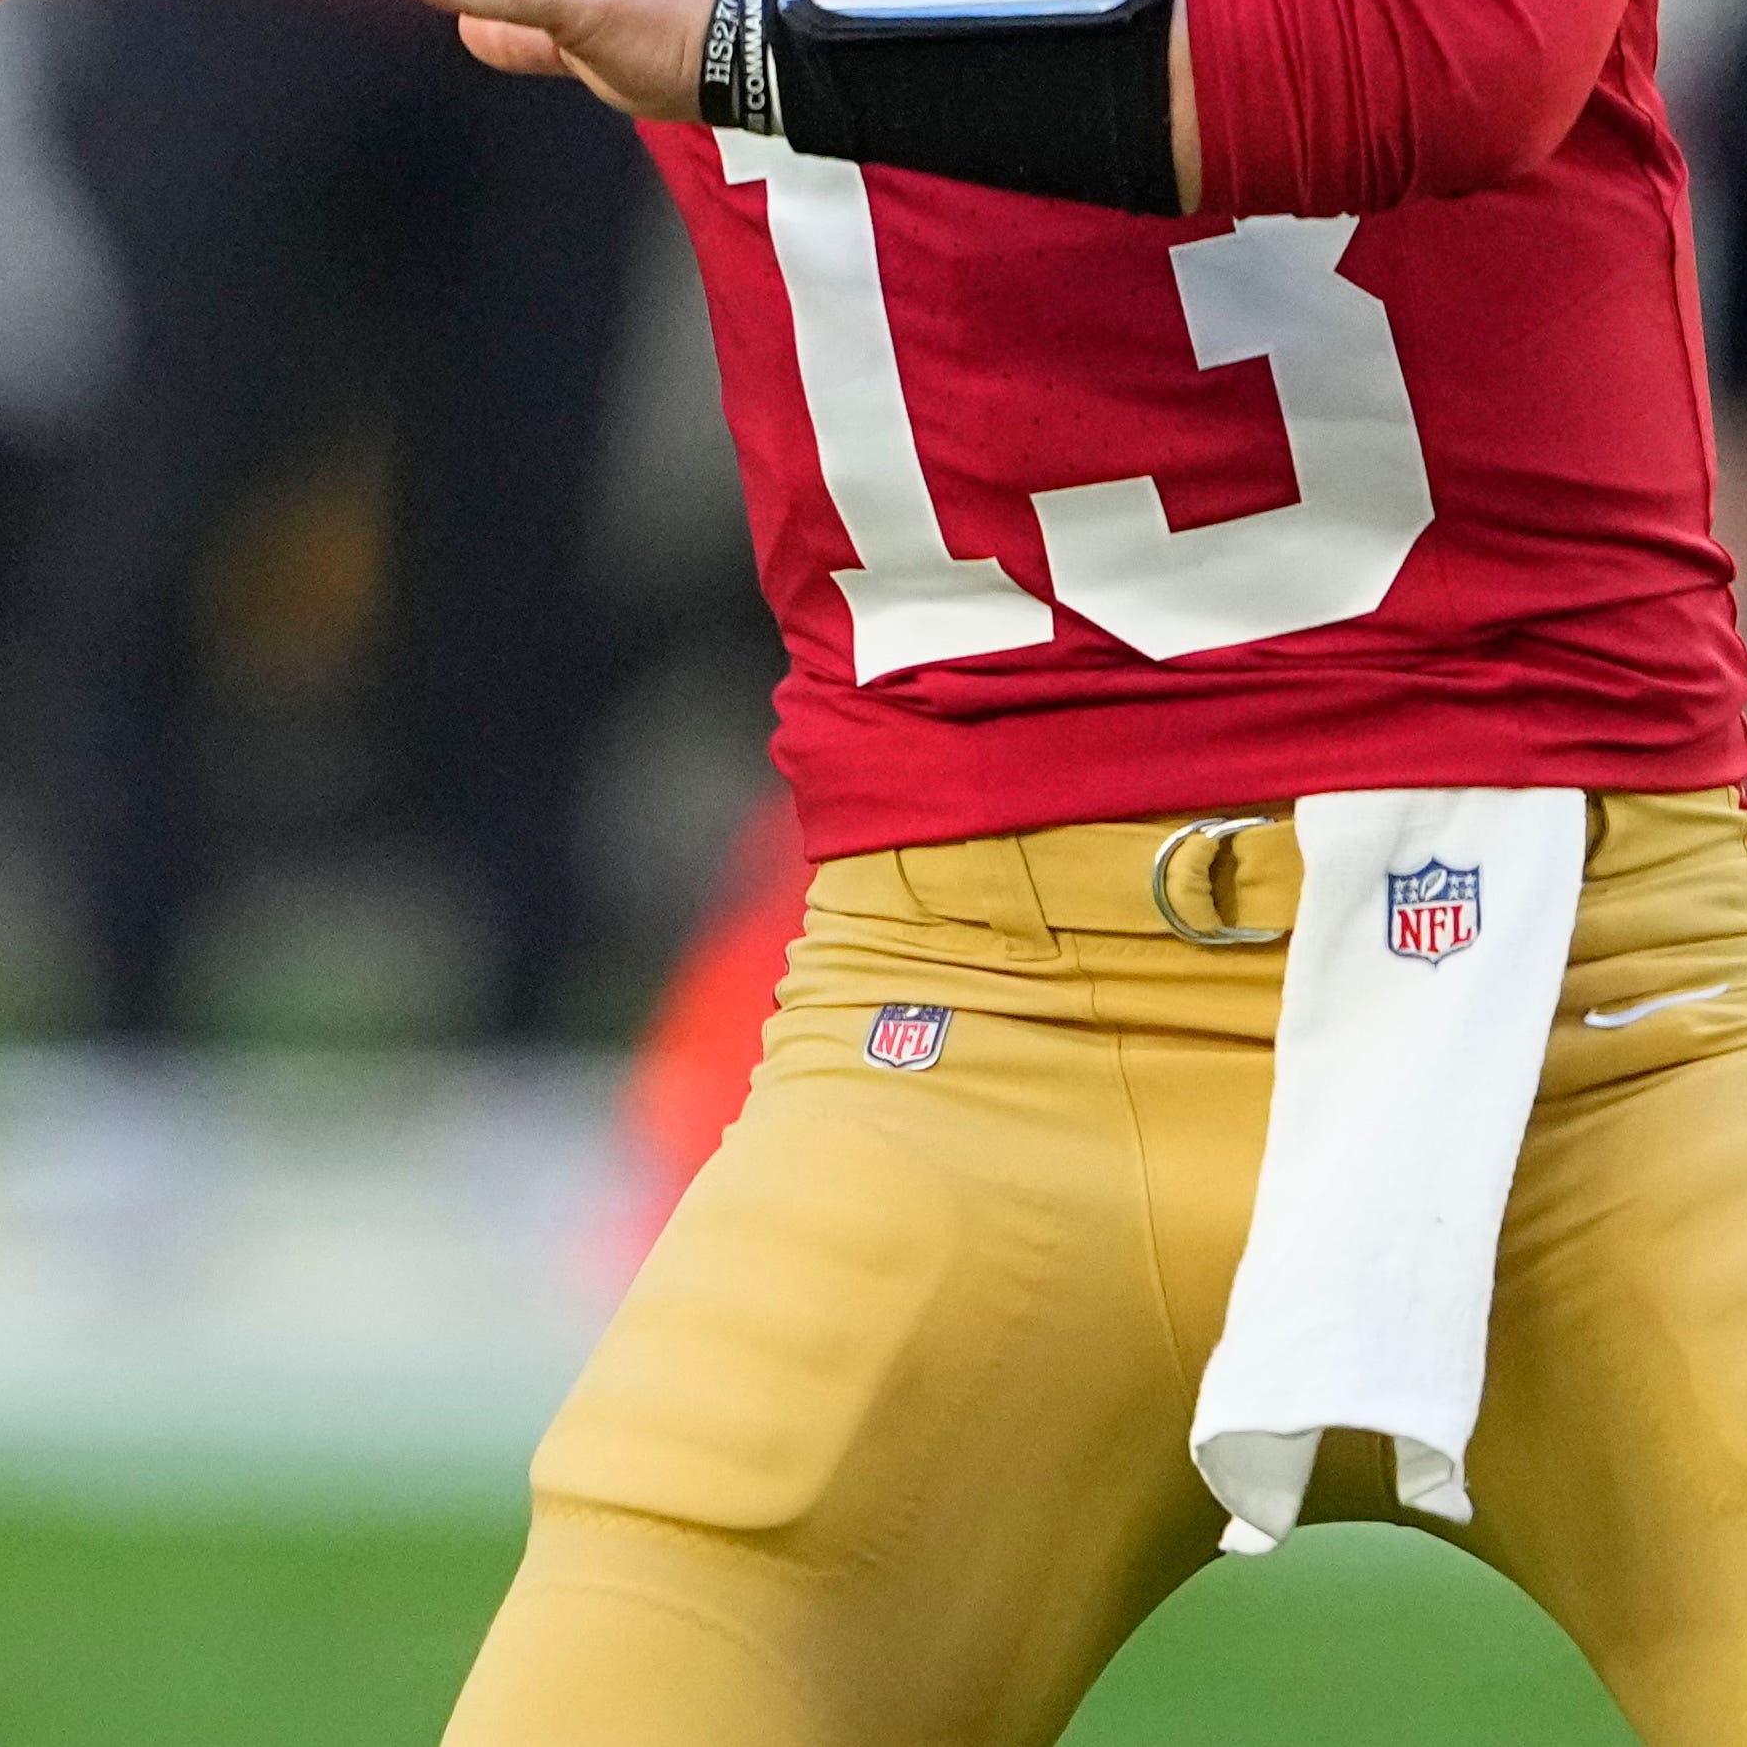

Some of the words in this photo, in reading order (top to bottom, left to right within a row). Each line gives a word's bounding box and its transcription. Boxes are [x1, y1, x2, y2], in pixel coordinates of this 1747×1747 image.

[712, 124, 1436, 688] 13
[1396, 904, 1473, 954] NFL
[875, 1022, 929, 1060] NFL
